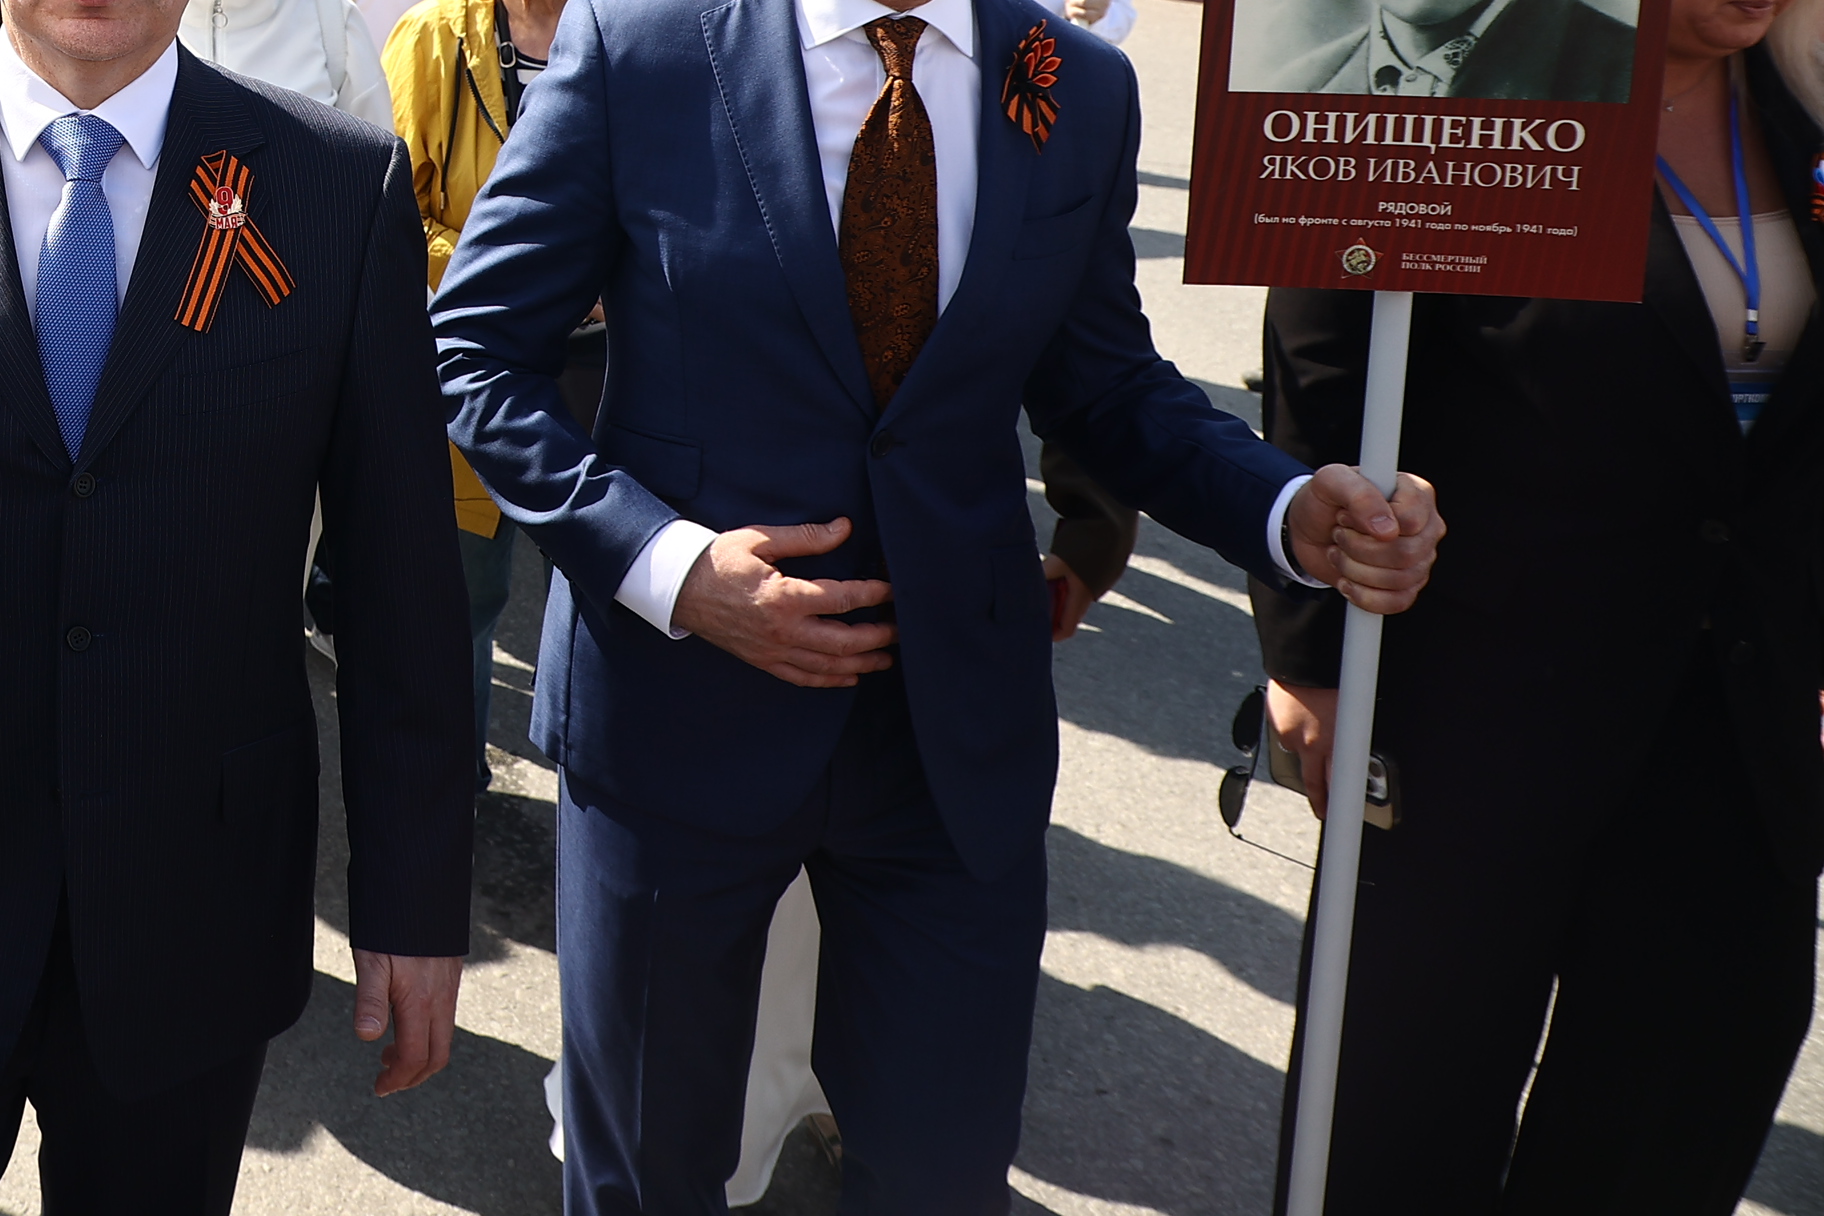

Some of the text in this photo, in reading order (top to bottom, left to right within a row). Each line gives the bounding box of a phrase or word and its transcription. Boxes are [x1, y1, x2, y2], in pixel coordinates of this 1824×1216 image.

[1263, 110, 1586, 154] ОНИЩЕНКО
[1259, 155, 1583, 191] ЯКОВ ИВАНОВИЧ
[216, 186, 234, 215] 9
[1378, 201, 1452, 216] РЯДОВОЙ
[216, 217, 238, 229] МАЯ
[1254, 213, 1279, 224] (был
[1282, 216, 1296, 224] на
[1298, 215, 1339, 227] фронте
[1349, 219, 1391, 229] августа
[1395, 218, 1422, 228] 1941
[1425, 222, 1452, 230] года
[1471, 223, 1512, 234] ноябрь
[1516, 224, 1544, 234] 1941
[1546, 226, 1578, 237] года)
[1401, 253, 1488, 264] БЕССМЕРТНЫЙ
[1401, 262, 1481, 273] ПОЛК РОССИИ
